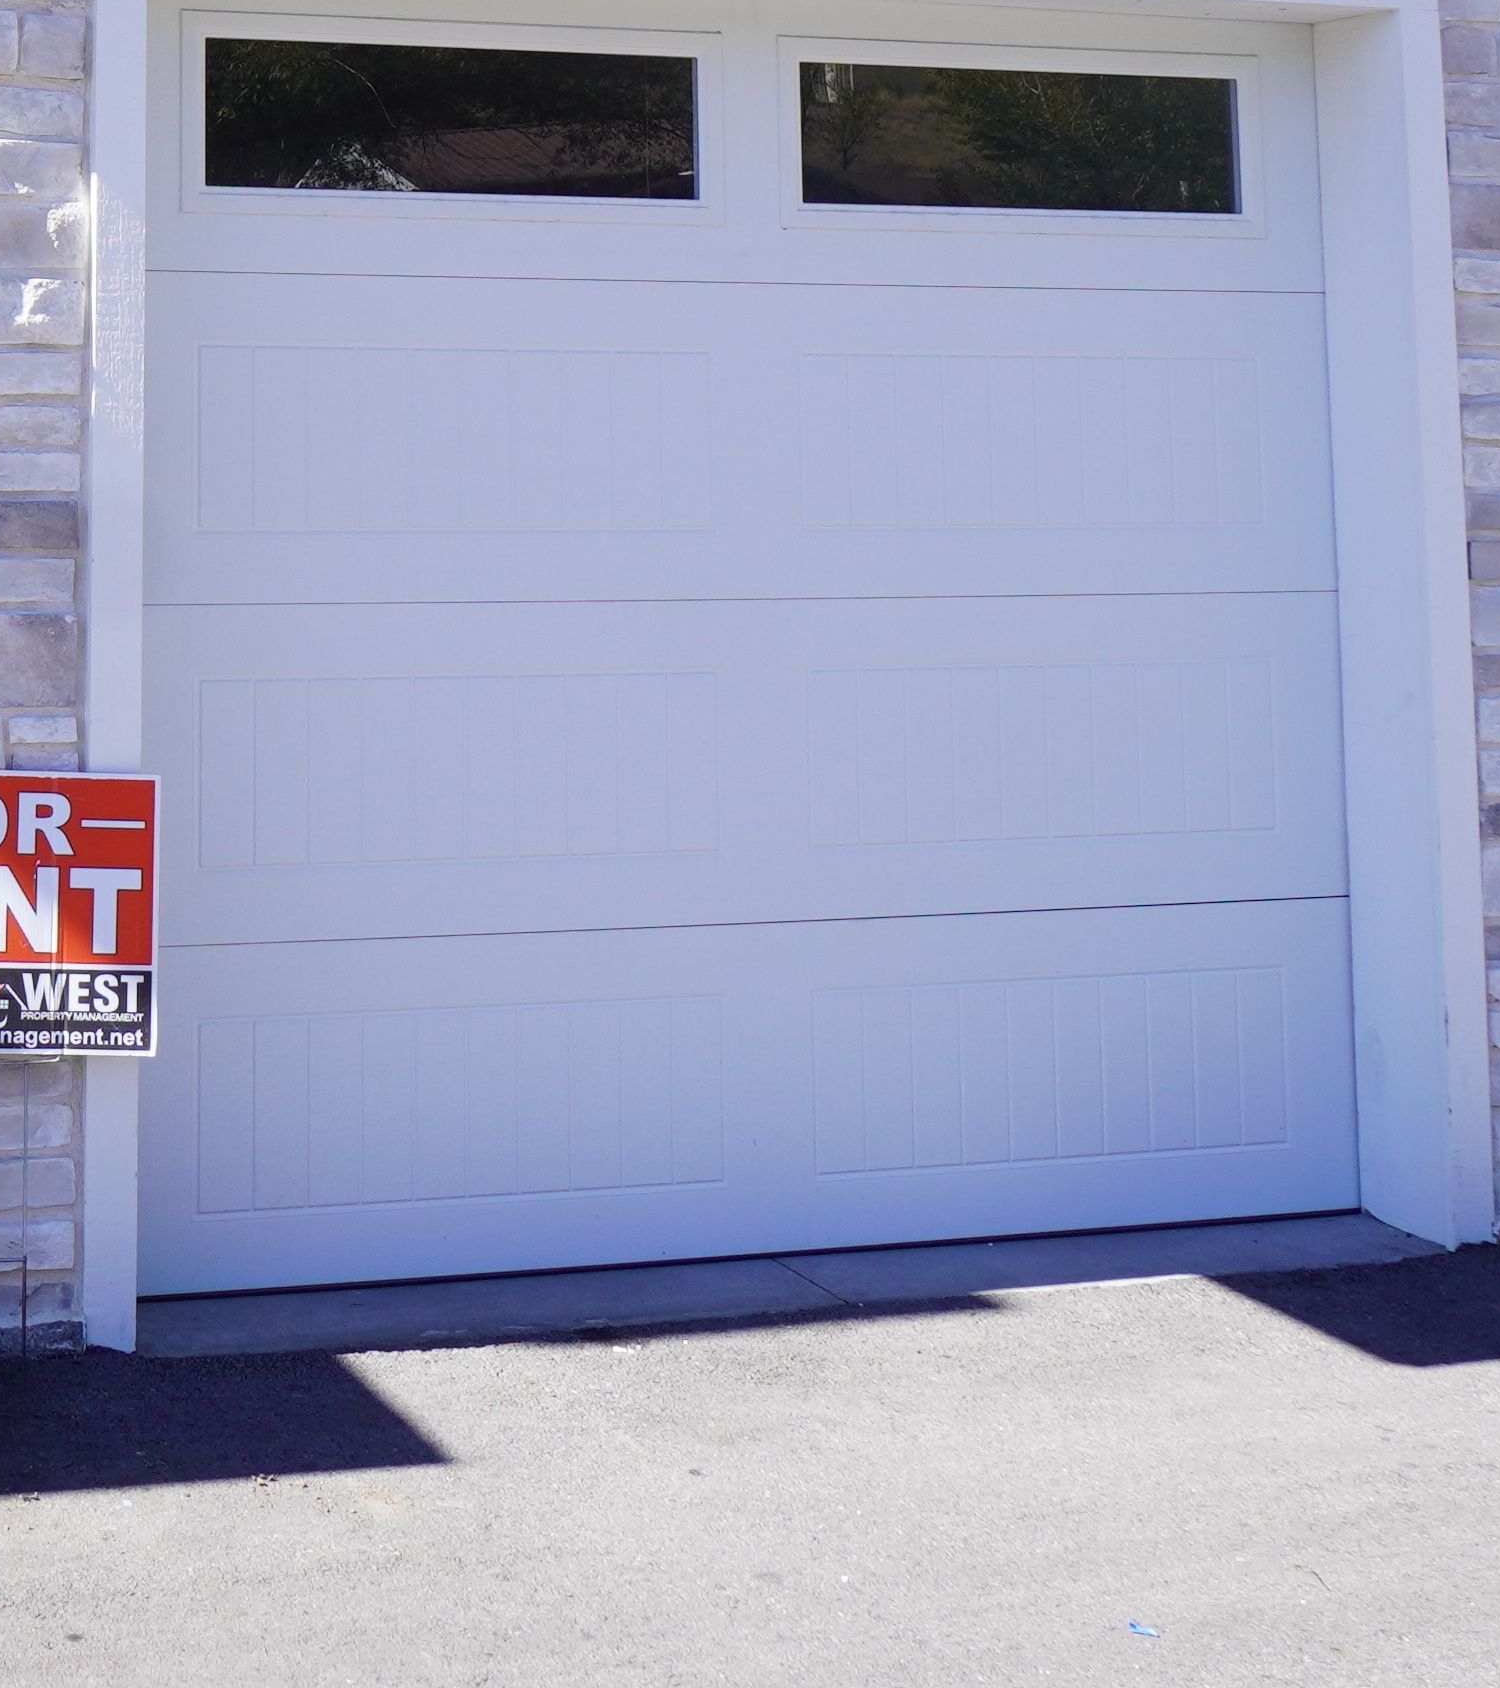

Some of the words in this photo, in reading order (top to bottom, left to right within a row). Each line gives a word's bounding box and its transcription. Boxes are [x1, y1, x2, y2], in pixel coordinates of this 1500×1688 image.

[22, 972, 144, 1013] WEST
[20, 1011, 72, 1021] PROPERTY
[73, 1012, 144, 1023] MANAGEMENT
